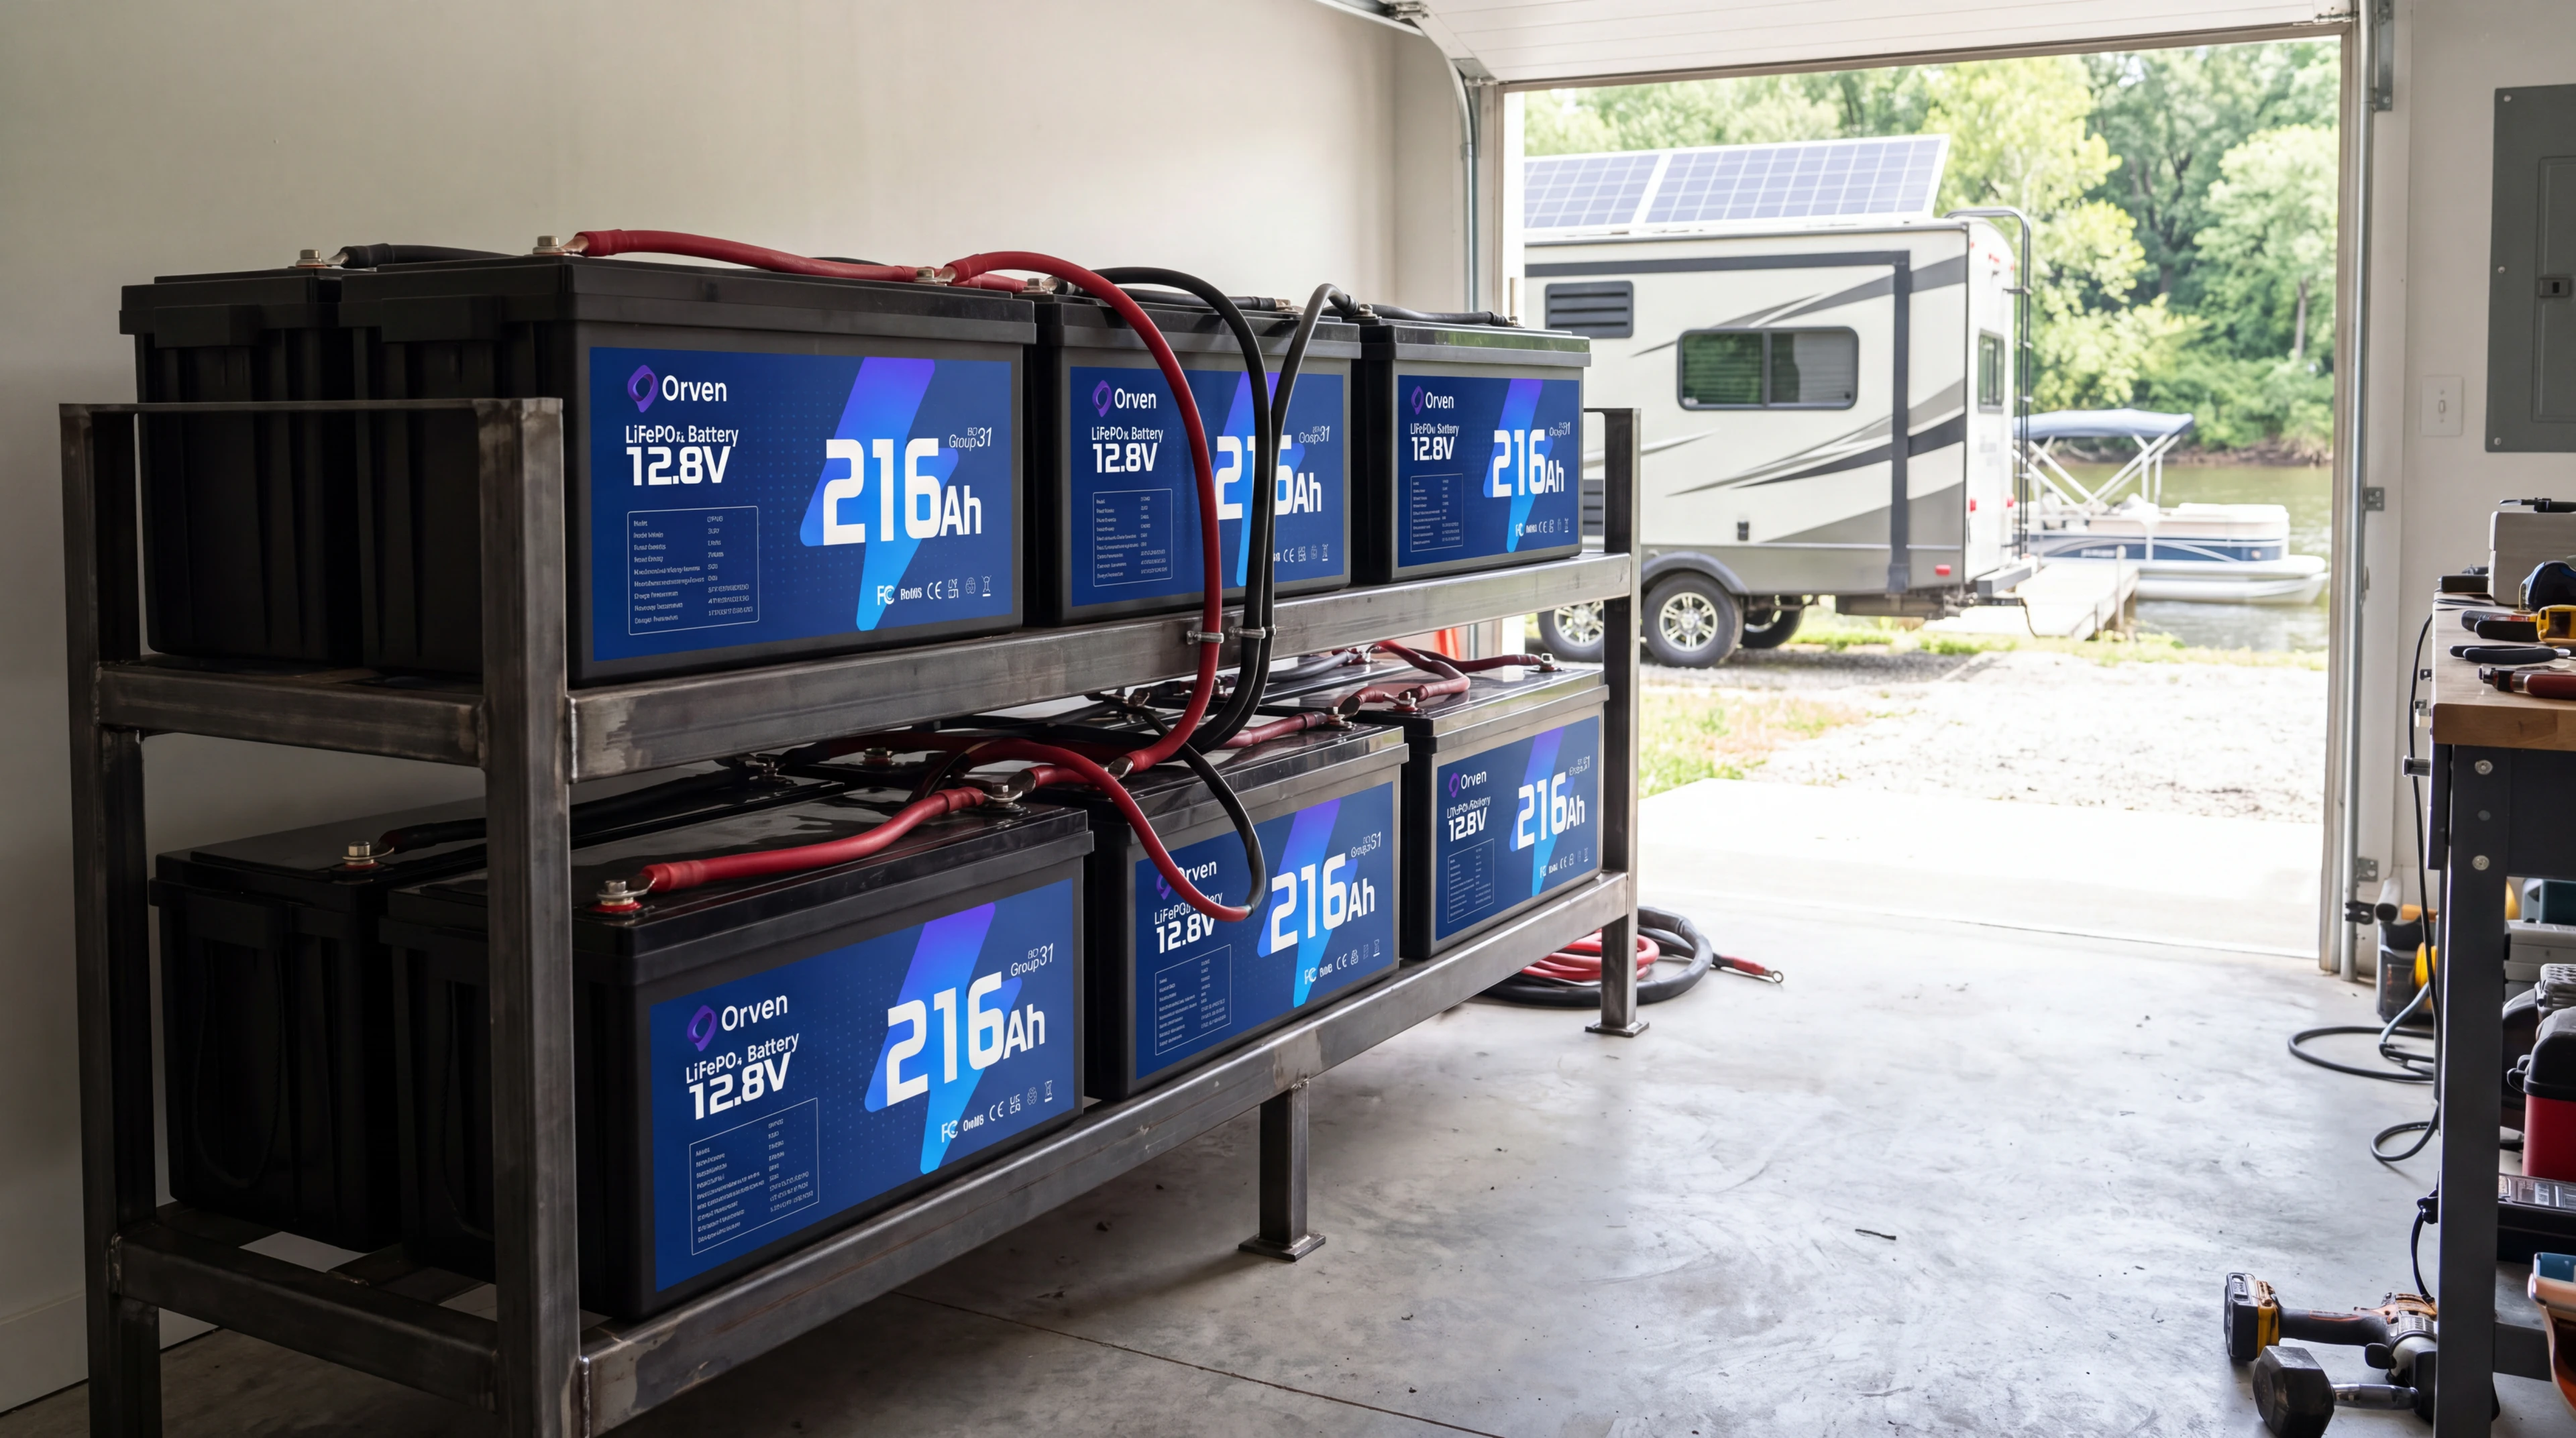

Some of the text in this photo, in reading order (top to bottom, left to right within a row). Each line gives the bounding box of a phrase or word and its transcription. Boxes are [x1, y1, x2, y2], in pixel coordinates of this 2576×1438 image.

[662, 375, 727, 402] Orven
[1114, 388, 1157, 409] Orven
[1425, 391, 1454, 409] Orven
[688, 425, 739, 447] Battery
[1131, 426, 1164, 443] Battery
[1092, 442, 1158, 474] 12.8V
[1411, 436, 1455, 461] 12.8V
[626, 445, 731, 486] 12.8V
[1493, 429, 1564, 498] 216Ah
[822, 437, 982, 546] 216Ah
[1538, 520, 1548, 533] CE
[1283, 547, 1295, 563] CE
[926, 581, 943, 600] CE
[1460, 771, 1487, 789] Orven
[1517, 771, 1585, 850] 216Ah
[1271, 852, 1375, 954] 216Ah
[1156, 912, 1215, 954] 12.8V
[1336, 953, 1347, 970] CE
[721, 995, 788, 1032] Orven
[747, 1033, 800, 1063] Battery
[886, 971, 1046, 1107] 216Ah
[688, 1051, 792, 1121] 12.8V
[989, 1101, 1004, 1121] CE
